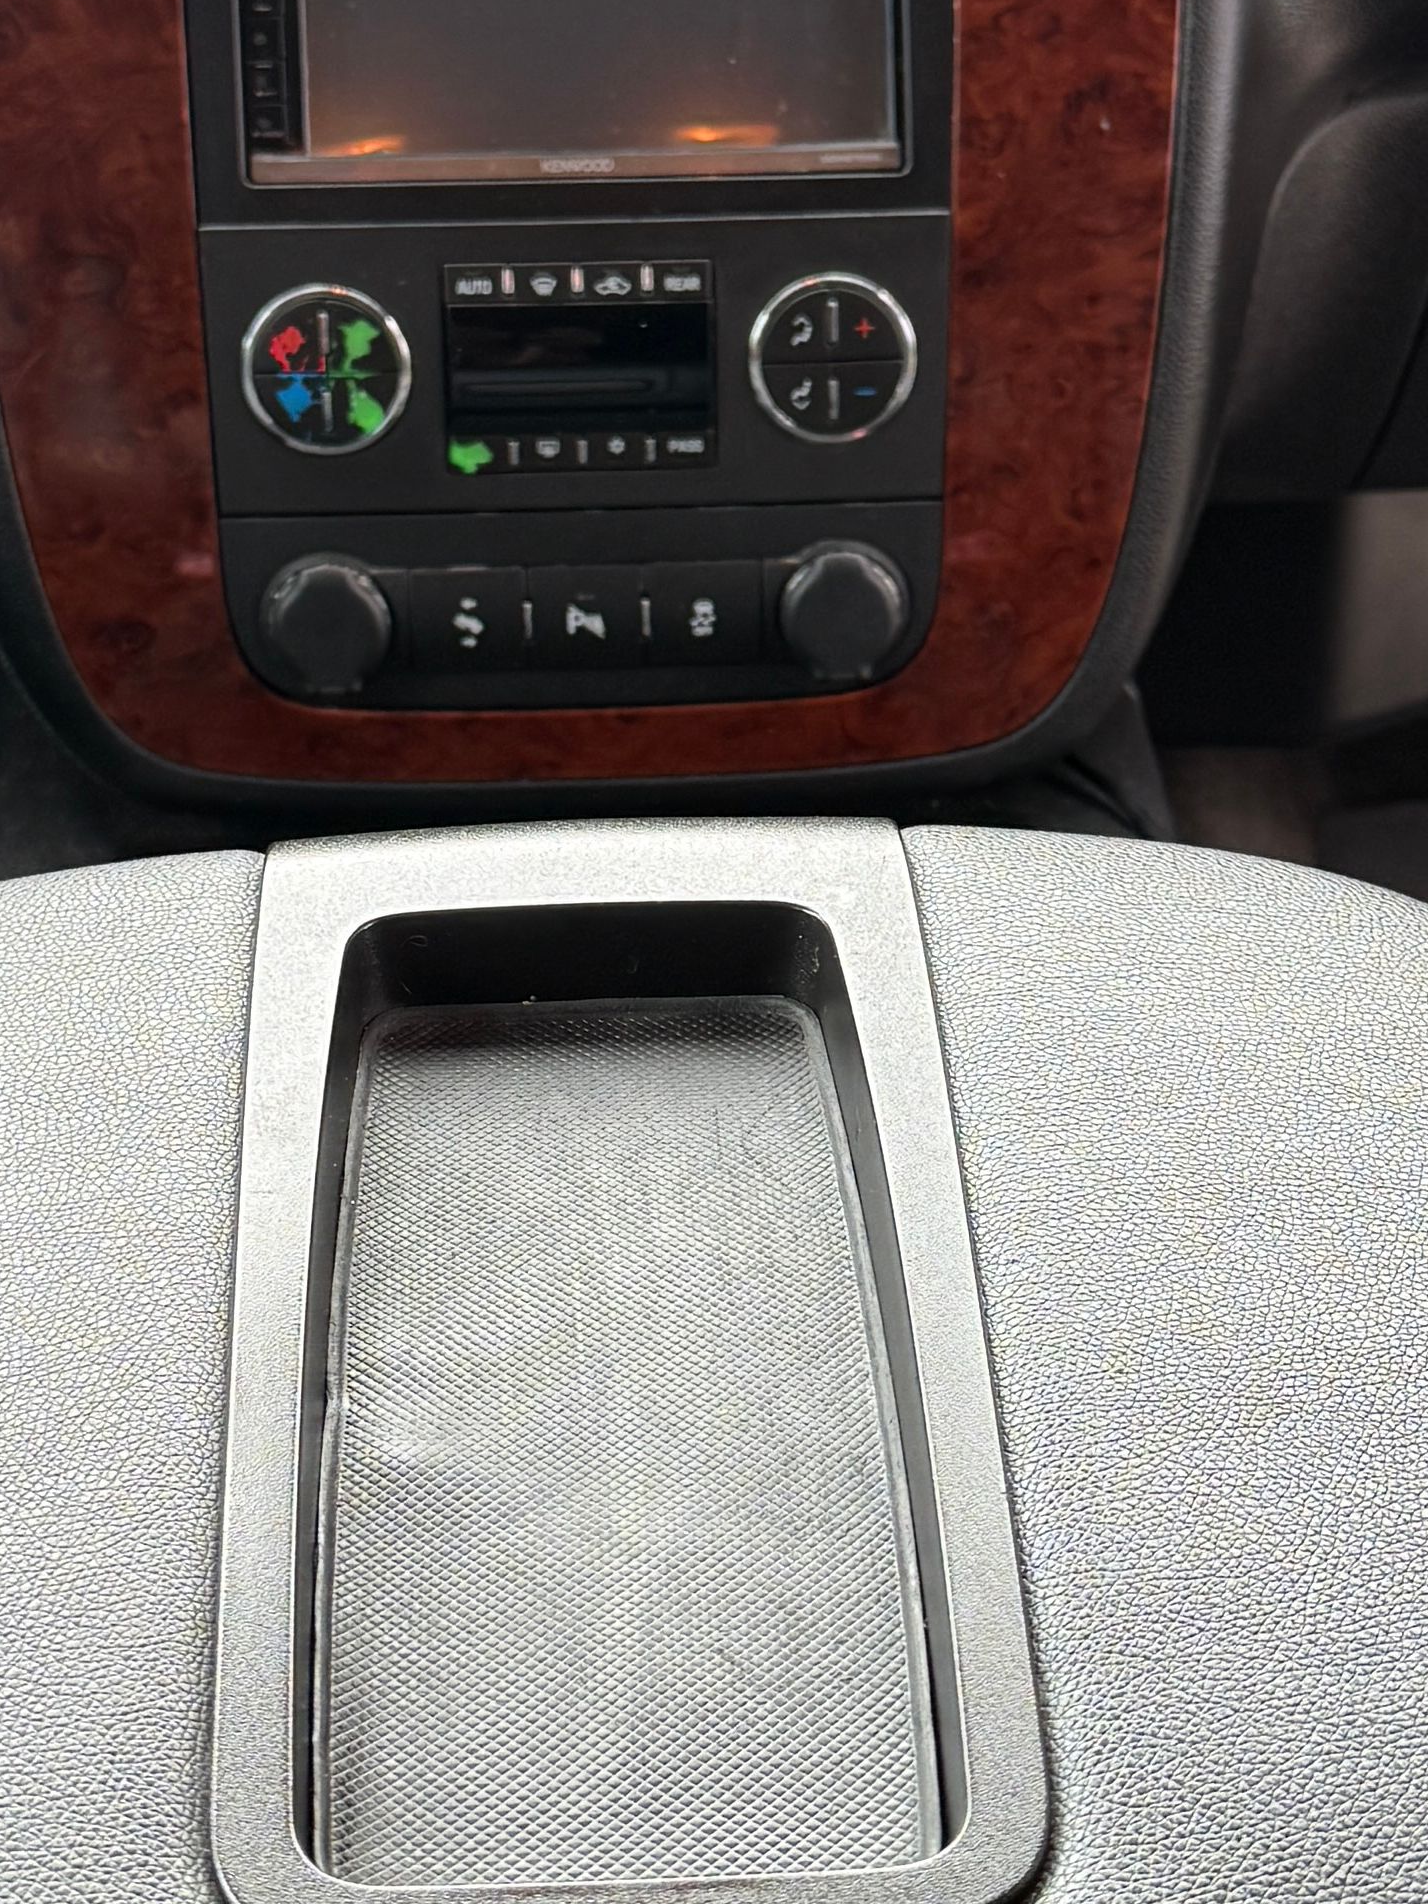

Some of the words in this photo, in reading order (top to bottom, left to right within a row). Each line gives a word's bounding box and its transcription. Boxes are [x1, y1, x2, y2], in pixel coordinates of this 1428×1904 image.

[539, 157, 616, 174] KENWOOD
[455, 276, 494, 296] AUTO
[662, 273, 702, 293] REAR
